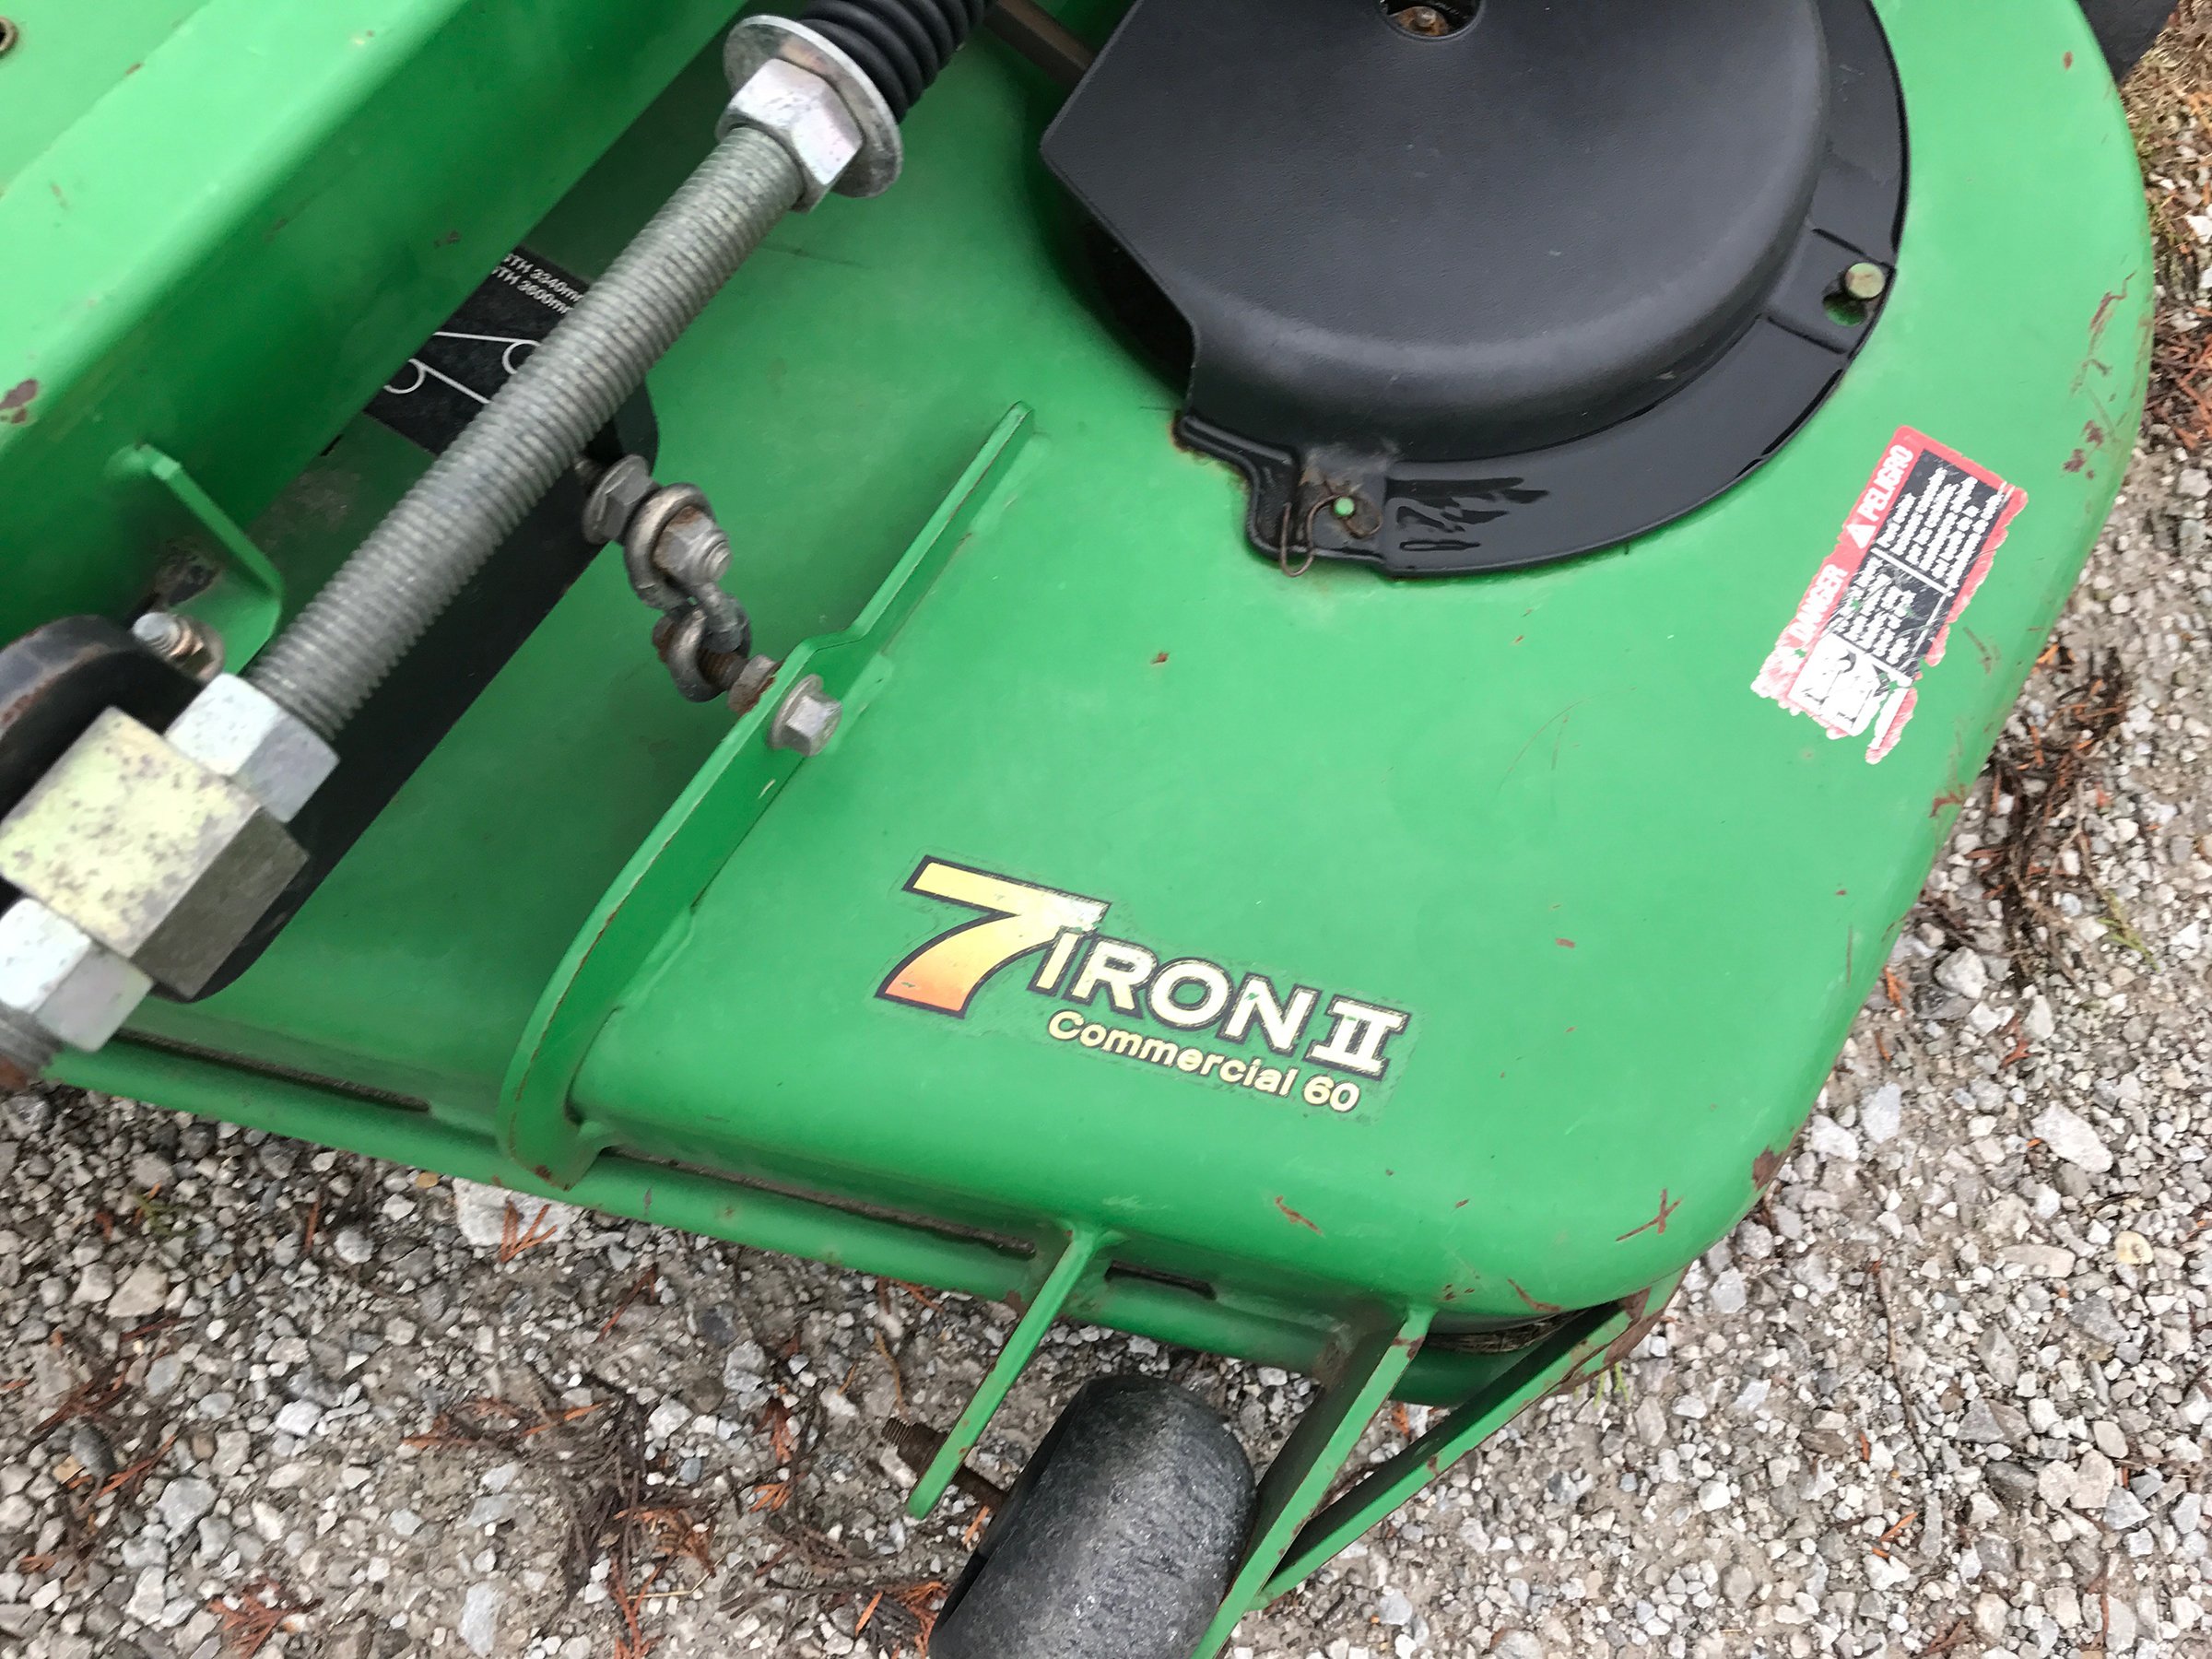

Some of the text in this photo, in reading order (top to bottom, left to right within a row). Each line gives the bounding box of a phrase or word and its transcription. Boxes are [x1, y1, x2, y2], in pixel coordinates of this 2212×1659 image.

[1856, 444, 1913, 523] PELIGRO
[1789, 563, 1848, 641] DANGER
[875, 854, 1411, 1080] 7 IRON II
[1047, 1009, 1360, 1113] Commercial 60
